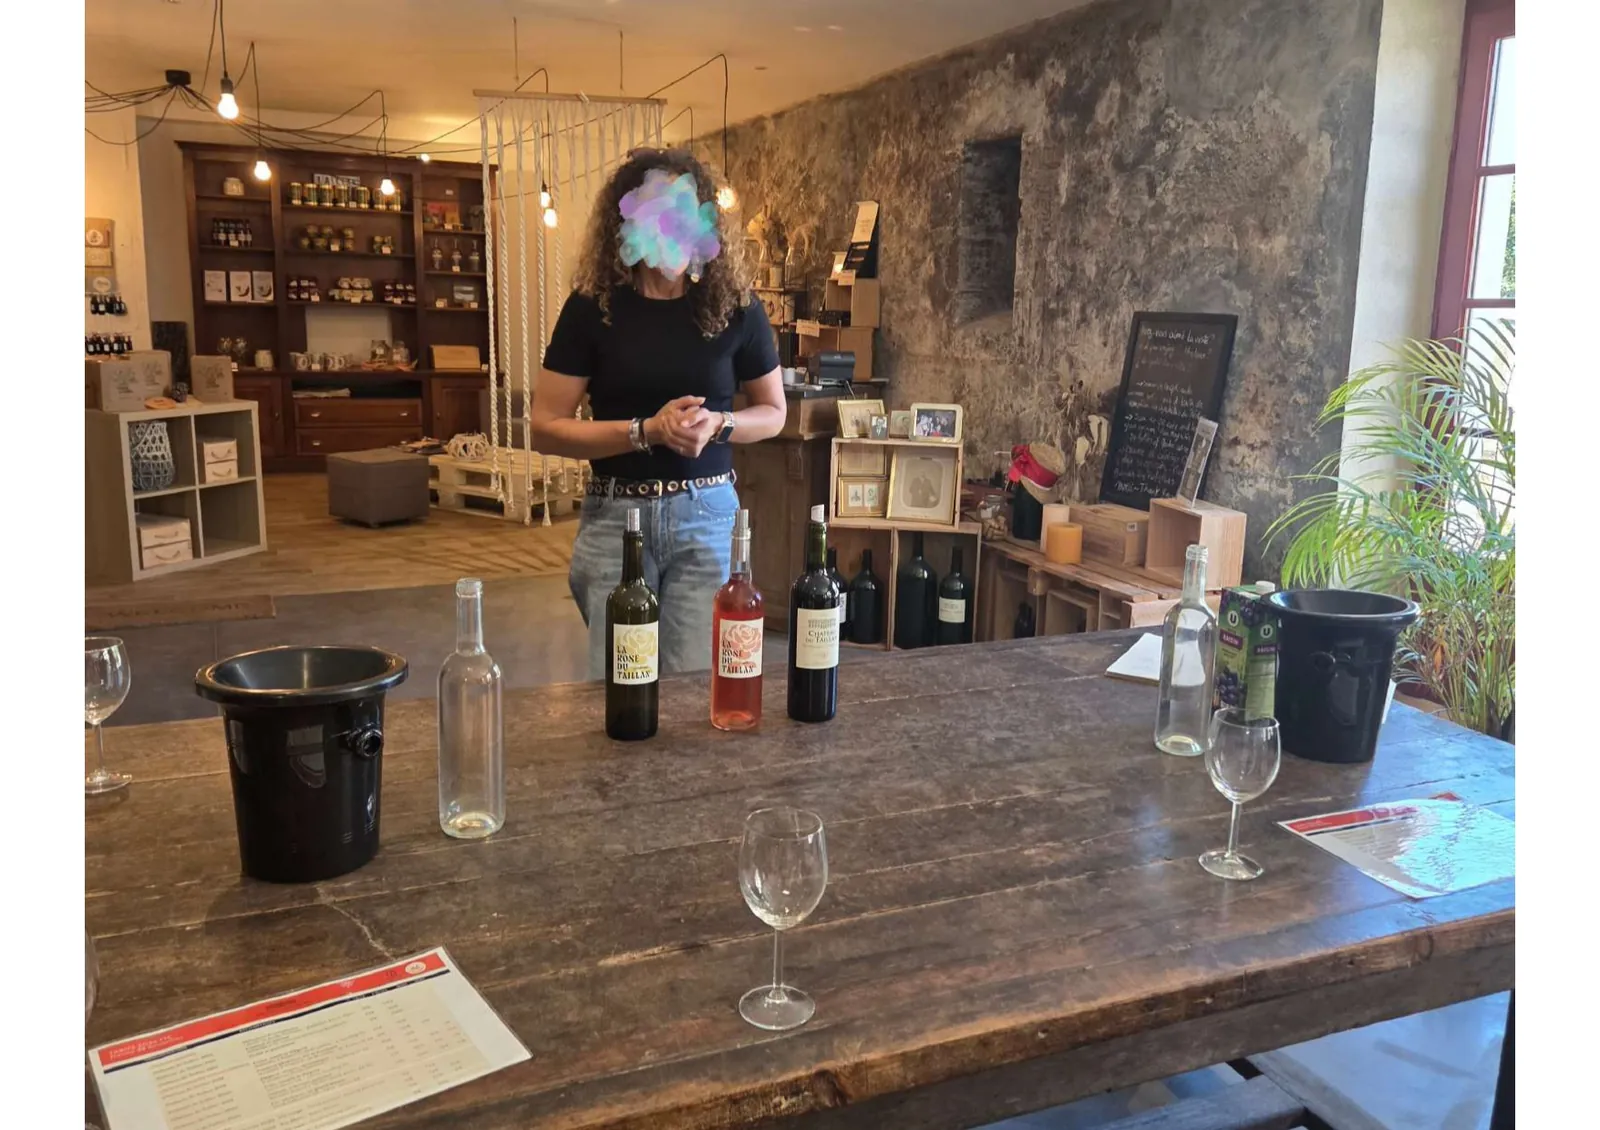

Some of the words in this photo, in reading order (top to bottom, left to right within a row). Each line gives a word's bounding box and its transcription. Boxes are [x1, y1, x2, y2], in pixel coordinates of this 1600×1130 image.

[1230, 612, 1237, 624] U
[1263, 627, 1270, 636] U
[722, 640, 732, 649] LA
[617, 645, 627, 654] LA
[722, 649, 742, 658] ROSE
[617, 654, 640, 663] ROSE
[722, 657, 733, 665] DU
[617, 663, 628, 671] DU
[721, 665, 754, 674] TAILLAN
[617, 670, 651, 680] TAILLAN
